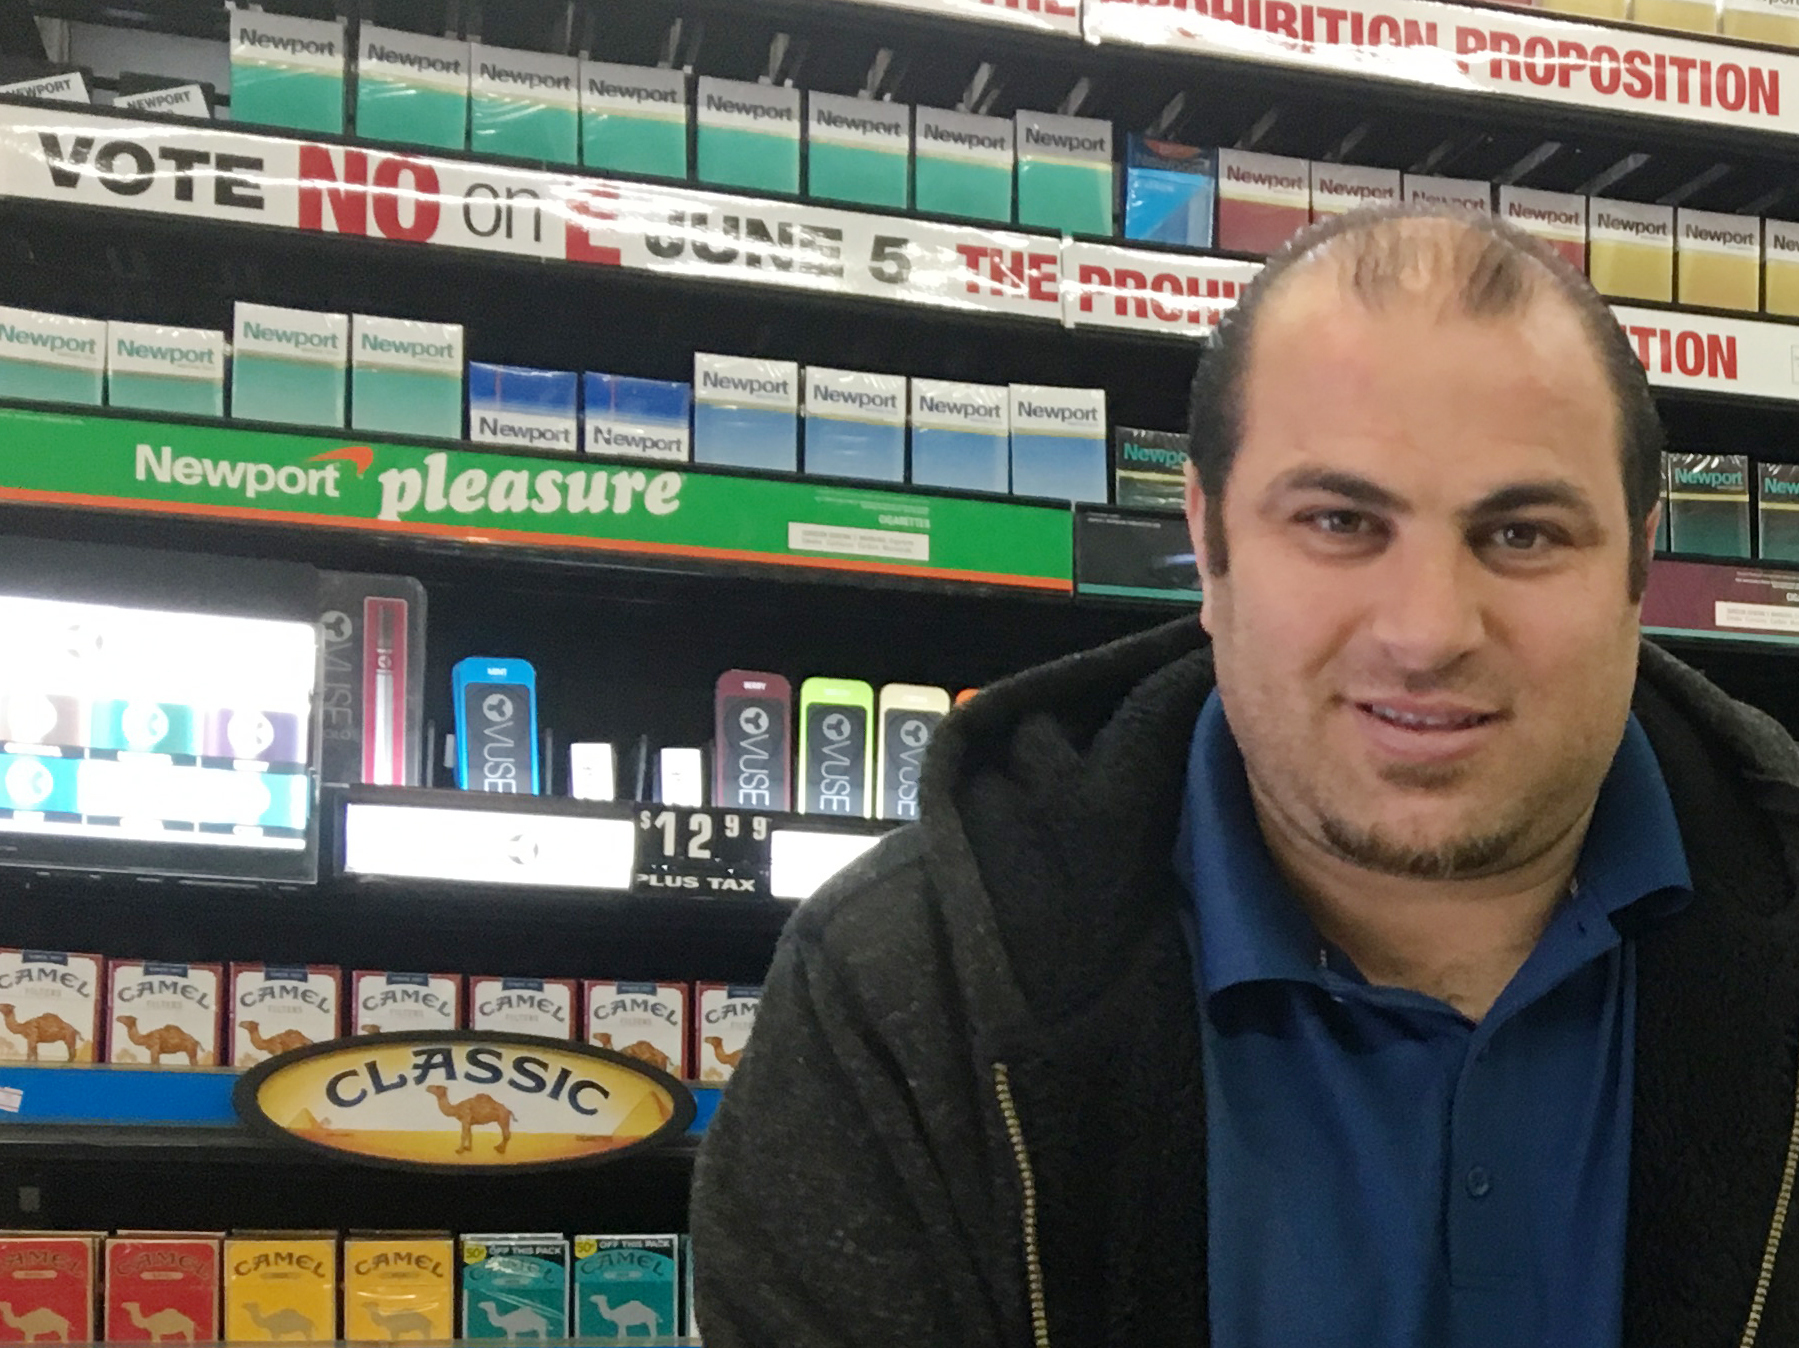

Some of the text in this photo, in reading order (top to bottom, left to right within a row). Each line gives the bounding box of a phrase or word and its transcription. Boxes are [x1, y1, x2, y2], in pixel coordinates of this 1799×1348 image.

[240, 27, 335, 57] Newport
[1456, 24, 1780, 116] PROPOSITION
[38, 131, 265, 210] VOTE
[300, 143, 441, 244] NO
[463, 180, 541, 243] on
[565, 183, 622, 266] E
[868, 235, 912, 284] 5
[957, 244, 1058, 302] THE
[1597, 212, 1668, 236] Newport
[361, 335, 455, 363] Newport
[1018, 402, 1098, 424] Newport
[135, 444, 684, 521] Newport pleasure
[116, 979, 210, 1010] CAMEL
[324, 1046, 610, 1117] CLASSIC
[233, 1249, 327, 1280] CAMEL
